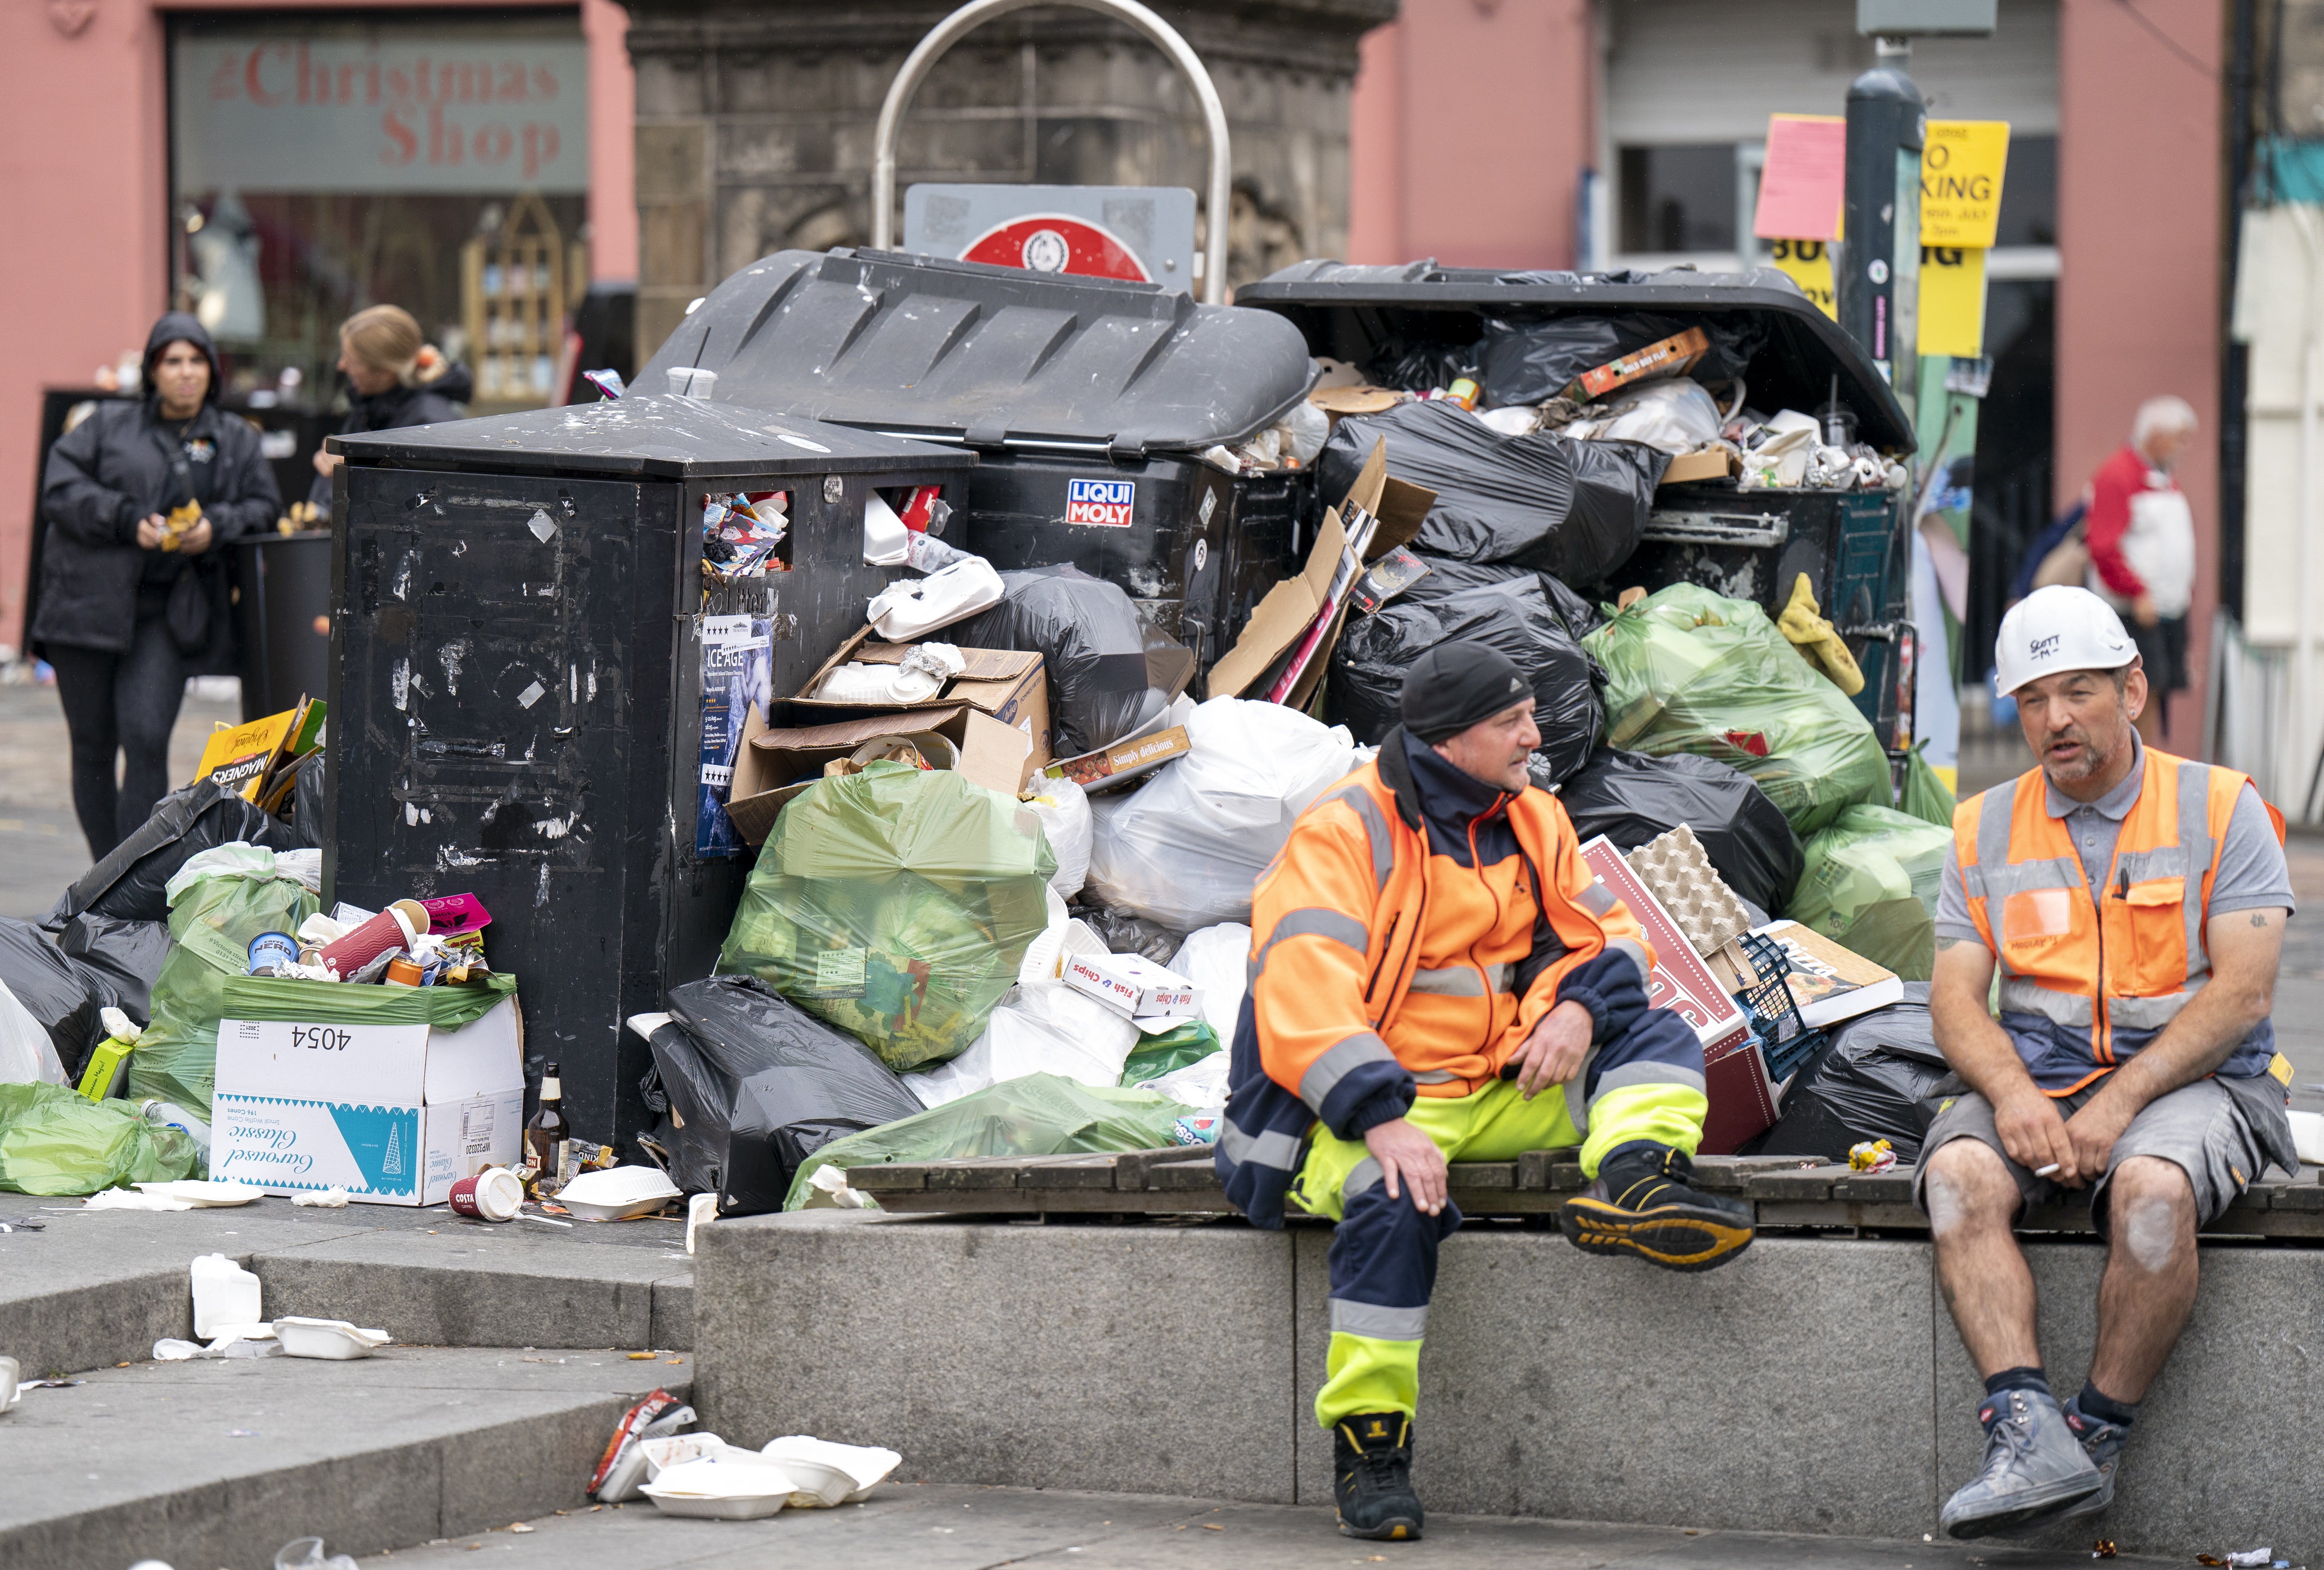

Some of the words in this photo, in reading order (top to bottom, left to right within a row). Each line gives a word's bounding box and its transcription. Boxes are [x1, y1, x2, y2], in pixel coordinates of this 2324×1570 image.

[245, 38, 559, 108] Christmas
[380, 100, 560, 179] Shop
[1072, 482, 1130, 503] LIQUI
[1070, 503, 1131, 524] MOLY
[726, 586, 767, 614] Litter
[2030, 634, 2060, 653] SCOTT
[707, 649, 722, 667] ICE
[724, 650, 744, 667] AGE
[1020, 686, 1032, 704] POMMES
[1032, 675, 1042, 689] FRITES
[1004, 701, 1017, 722] Aviko
[231, 727, 269, 753] Original
[233, 755, 245, 764] CIDER
[1112, 750, 1139, 767] Simply
[1139, 739, 1174, 758] delicious
[212, 755, 269, 784] MAGNERS
[213, 939, 233, 955] Victoria
[254, 943, 292, 957] NERO
[460, 936, 480, 946] Stand
[216, 949, 229, 960] 0131
[1073, 964, 1100, 982] Chips
[1102, 979, 1112, 988] &
[1114, 983, 1134, 998] Fish
[1156, 992, 1172, 1005] Chips
[1172, 994, 1179, 1004] &
[1179, 994, 1192, 1004] Fish
[292, 1026, 352, 1051] 4054
[94, 1060, 106, 1078] Magic!
[226, 1126, 296, 1149] Classic
[466, 1142, 490, 1155] WP320320
[578, 1152, 599, 1163] KIND
[223, 1149, 313, 1174] Carousel
[430, 1158, 452, 1171] Classic
[427, 1171, 457, 1189] Carousel
[455, 1194, 474, 1203] COSTA
